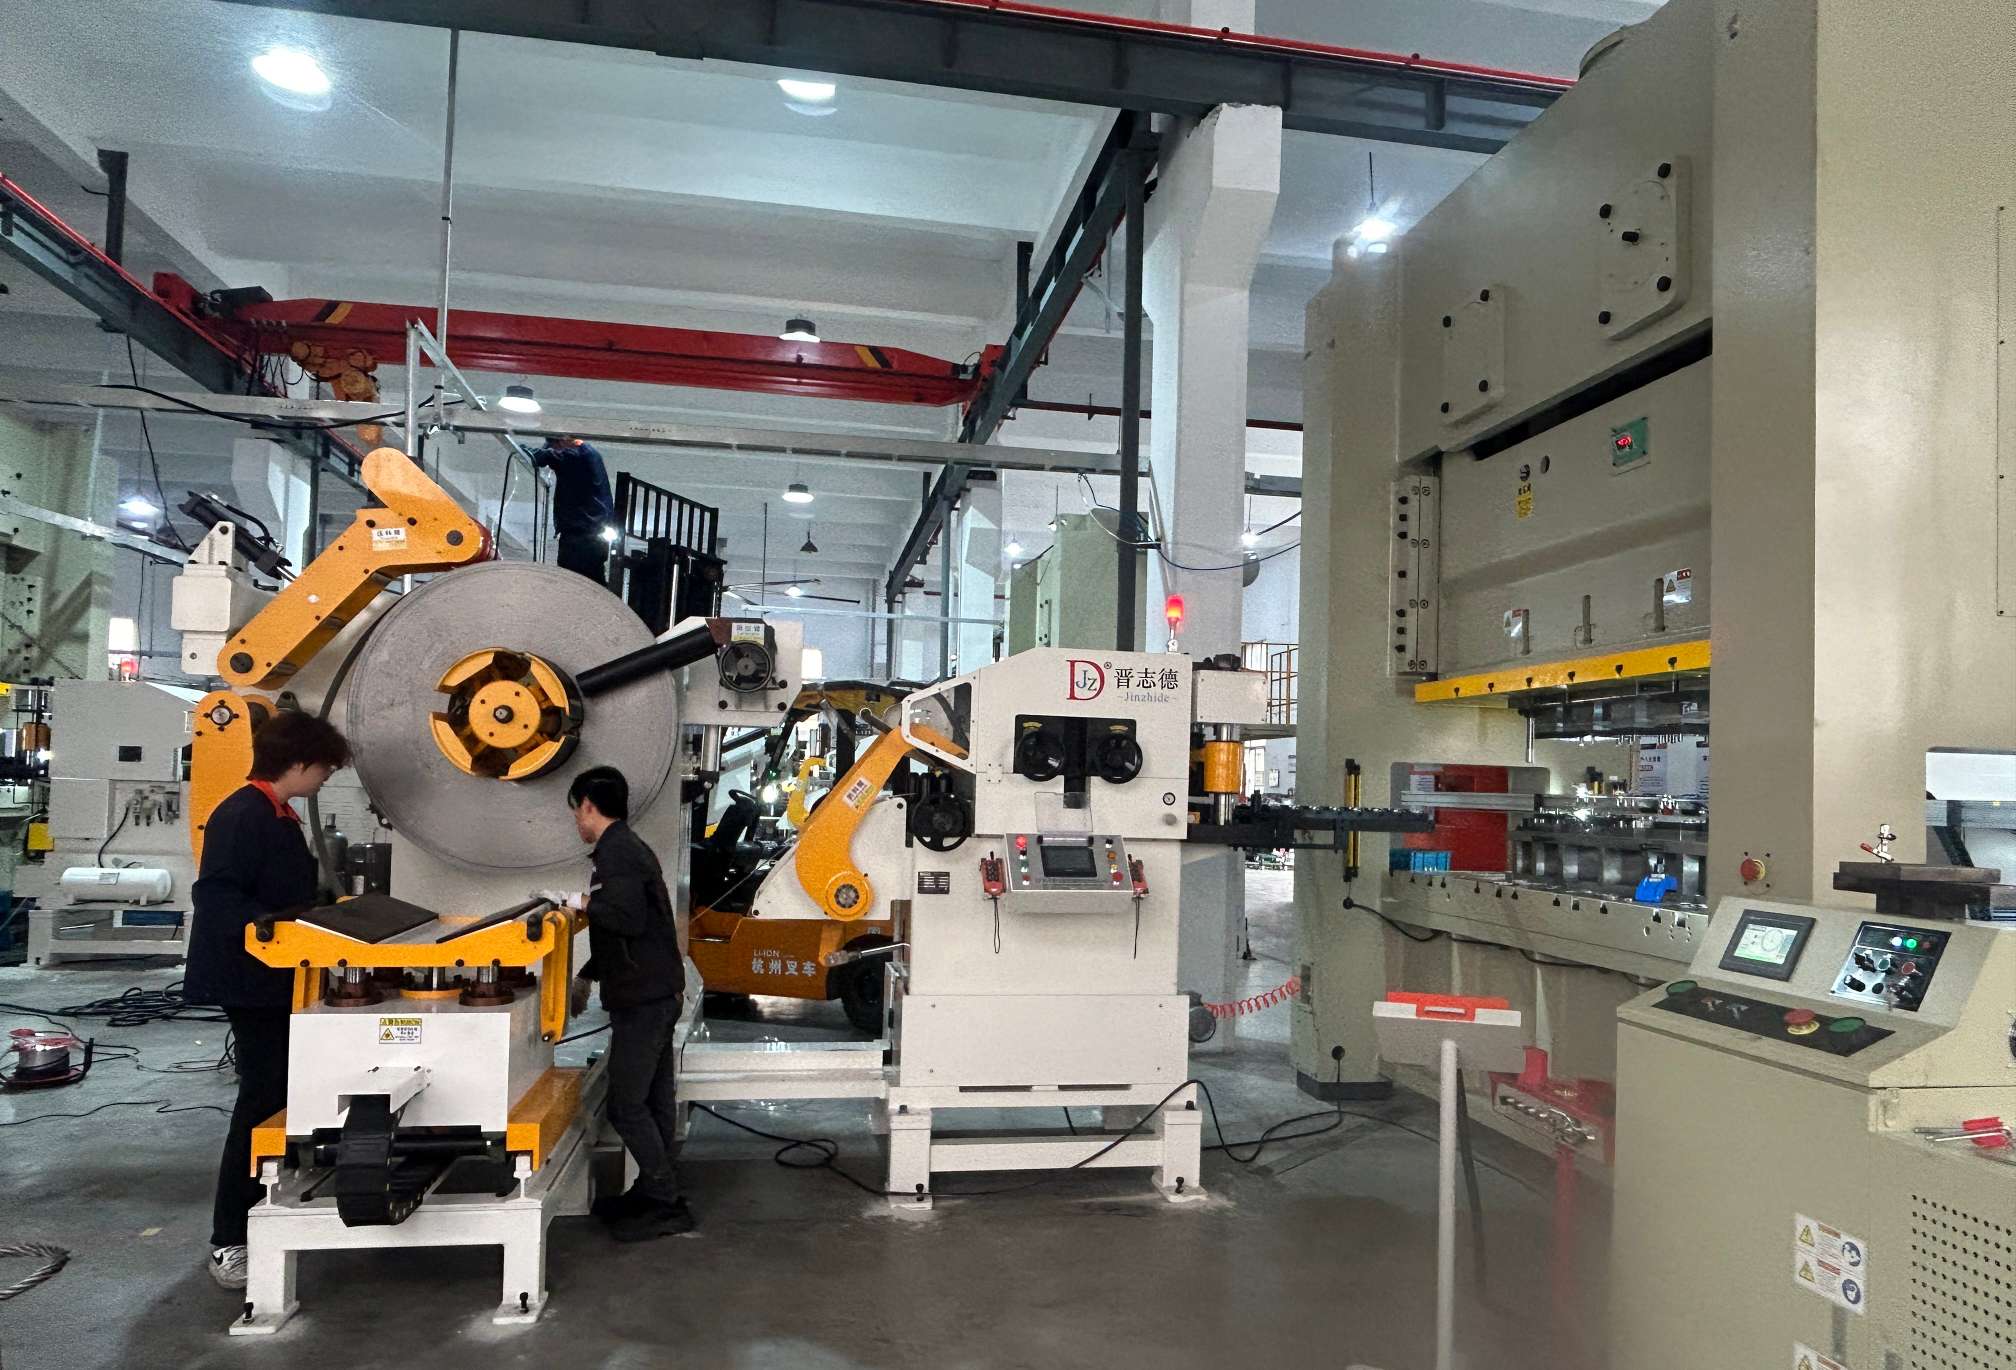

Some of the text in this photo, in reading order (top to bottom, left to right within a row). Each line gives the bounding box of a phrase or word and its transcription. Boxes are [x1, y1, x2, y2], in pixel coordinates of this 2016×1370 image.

[1114, 668, 1179, 690] 晋志德
[751, 958, 817, 977] 杭州叉车
